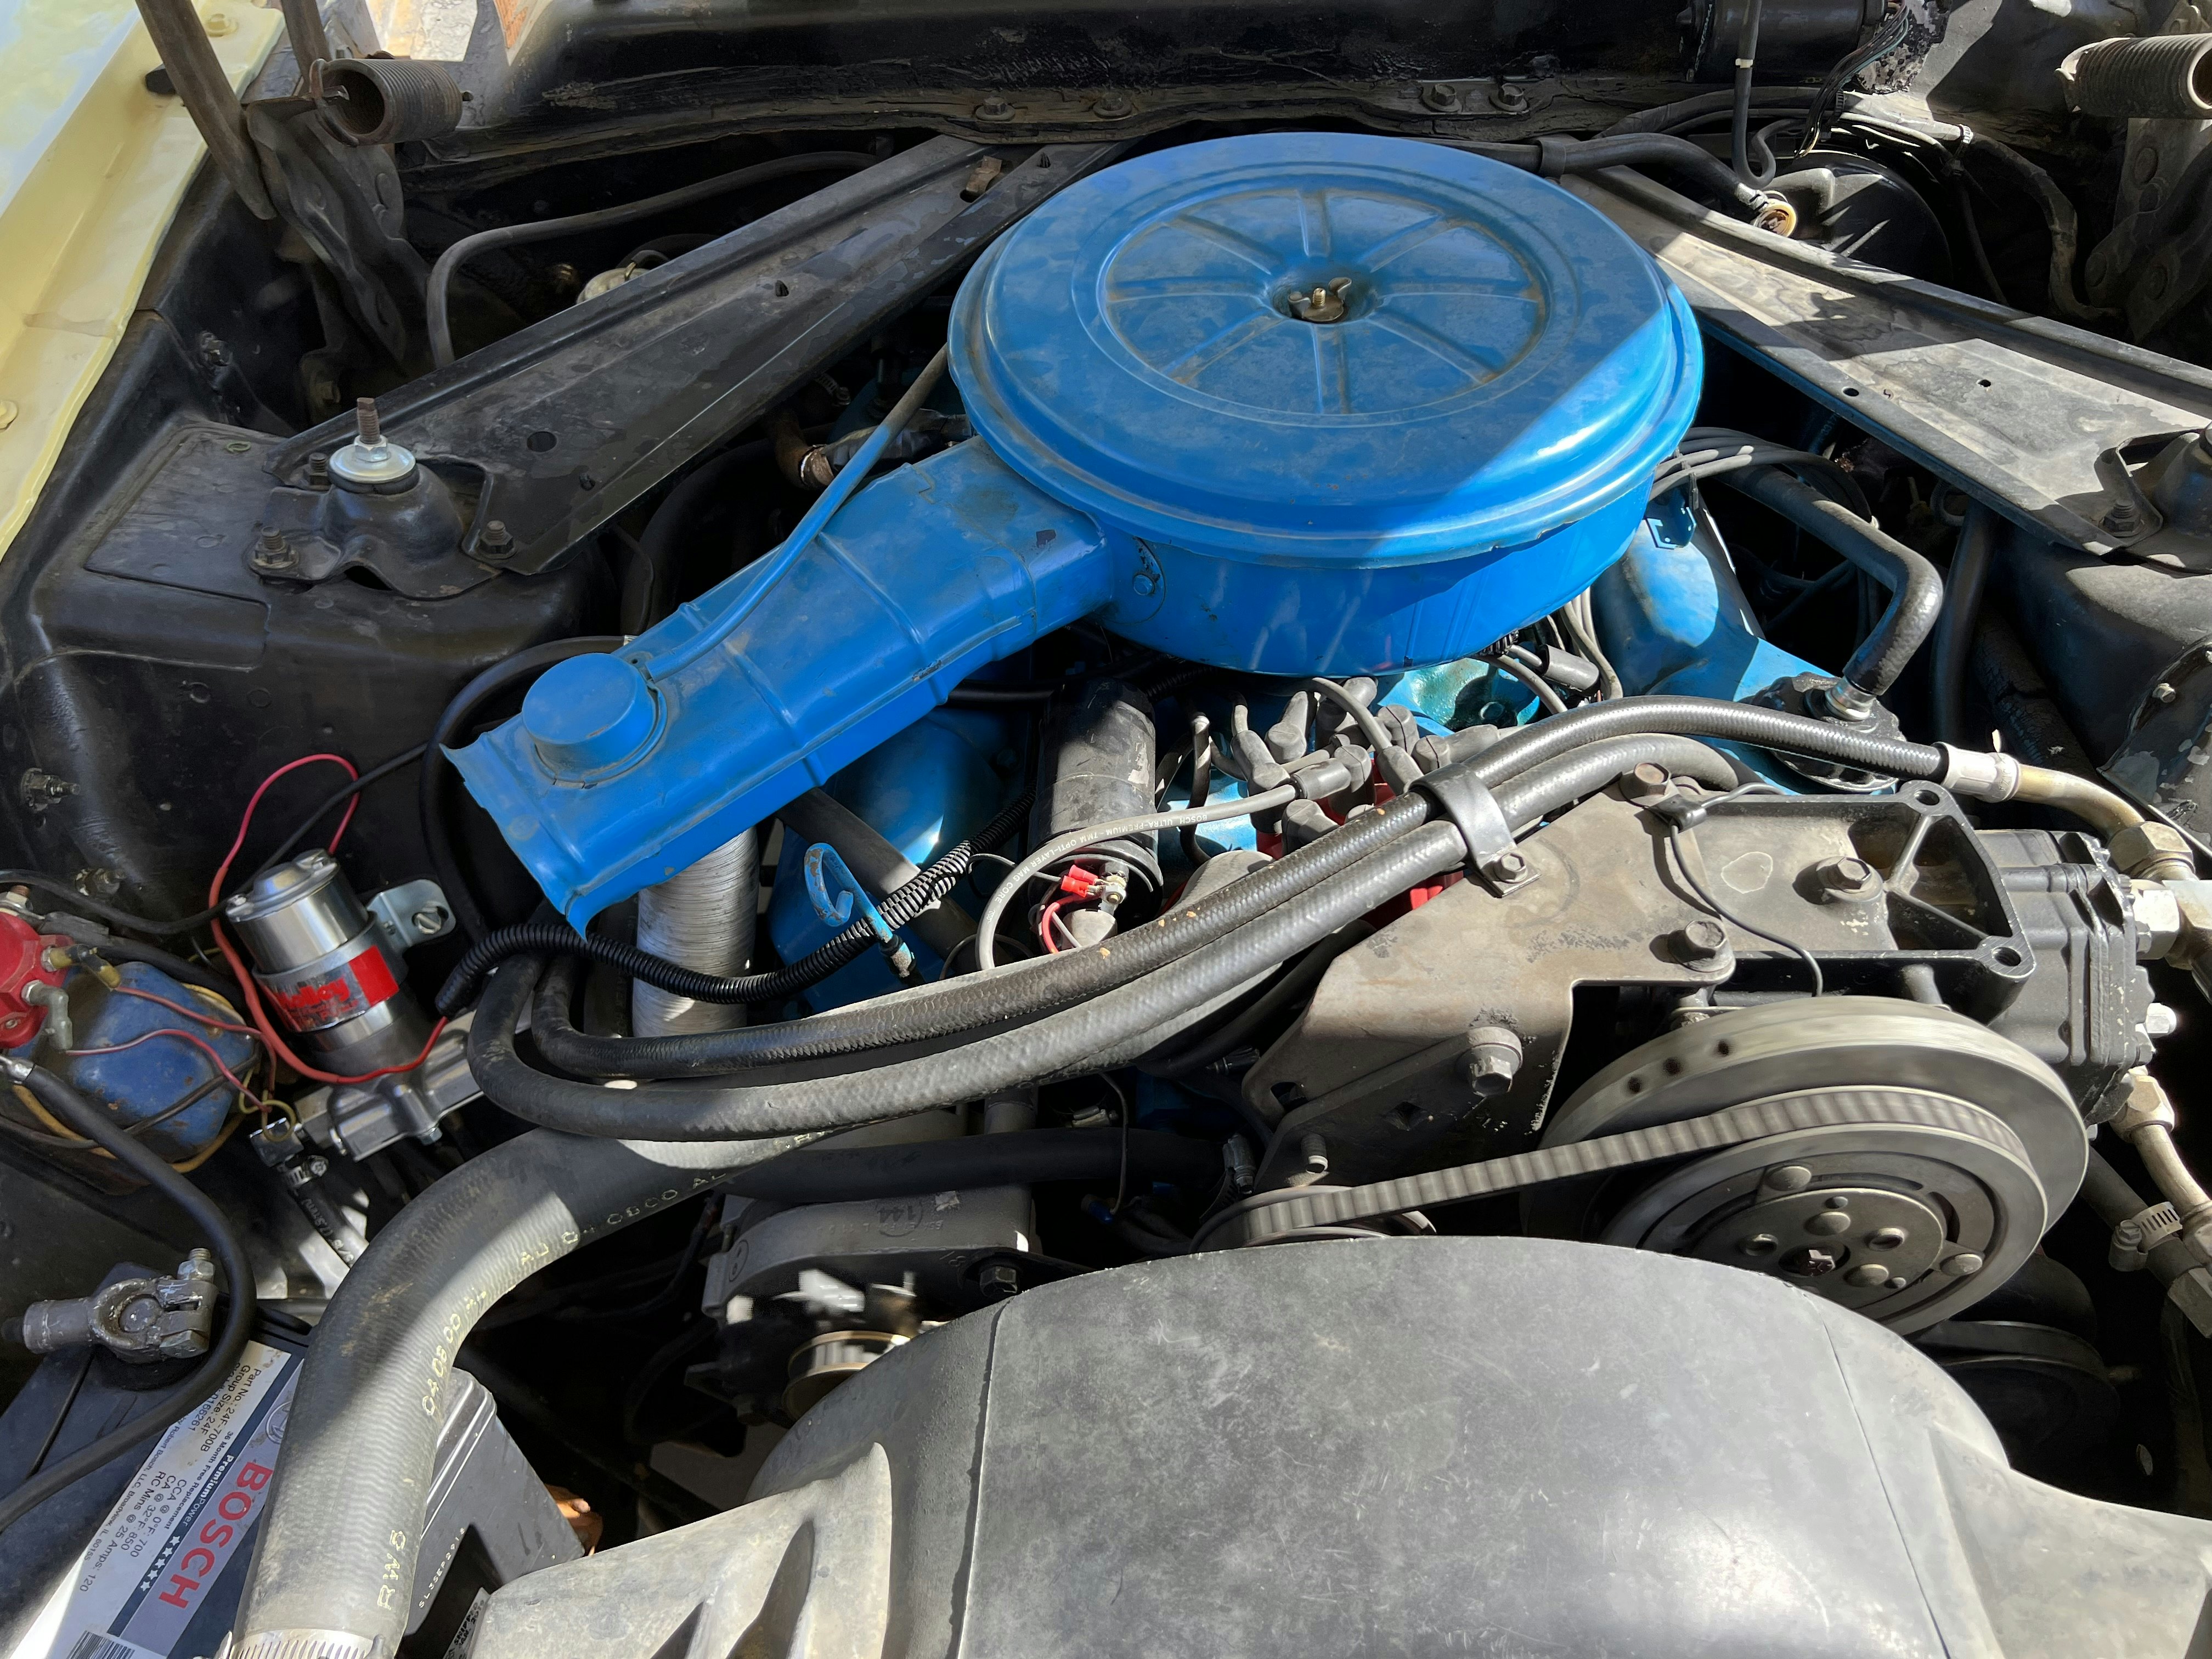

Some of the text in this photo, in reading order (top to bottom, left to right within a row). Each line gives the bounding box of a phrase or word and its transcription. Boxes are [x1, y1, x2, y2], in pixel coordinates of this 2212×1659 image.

[1106, 818, 1173, 835] ULTRA-PREMIUM
[1179, 814, 1208, 825] BOSCH
[1080, 832, 1098, 843] 7MM
[1030, 840, 1076, 867] OPTI-LAYER
[1013, 866, 1030, 882] MAG
[995, 882, 1013, 904] CORE
[228, 1365, 251, 1391] Group
[243, 1369, 262, 1386] Part
[211, 1394, 232, 1415] Size:
[200, 1407, 235, 1452] 24F-700B
[201, 1417, 215, 1435] 24F
[160, 1426, 180, 1449] Robert
[144, 1449, 163, 1471] Bosch,
[161, 1475, 176, 1488] CA
[164, 1431, 233, 1529] 36 Month Free Replacement
[154, 1493, 163, 1502] @
[167, 1480, 187, 1500] CCA
[160, 1505, 170, 1514] @
[80, 1471, 166, 1592] RC Mins @ 25 Amps: 120
[121, 1532, 137, 1550] 850
[160, 1462, 273, 1608] BOSCH
[130, 1539, 148, 1558] 700
